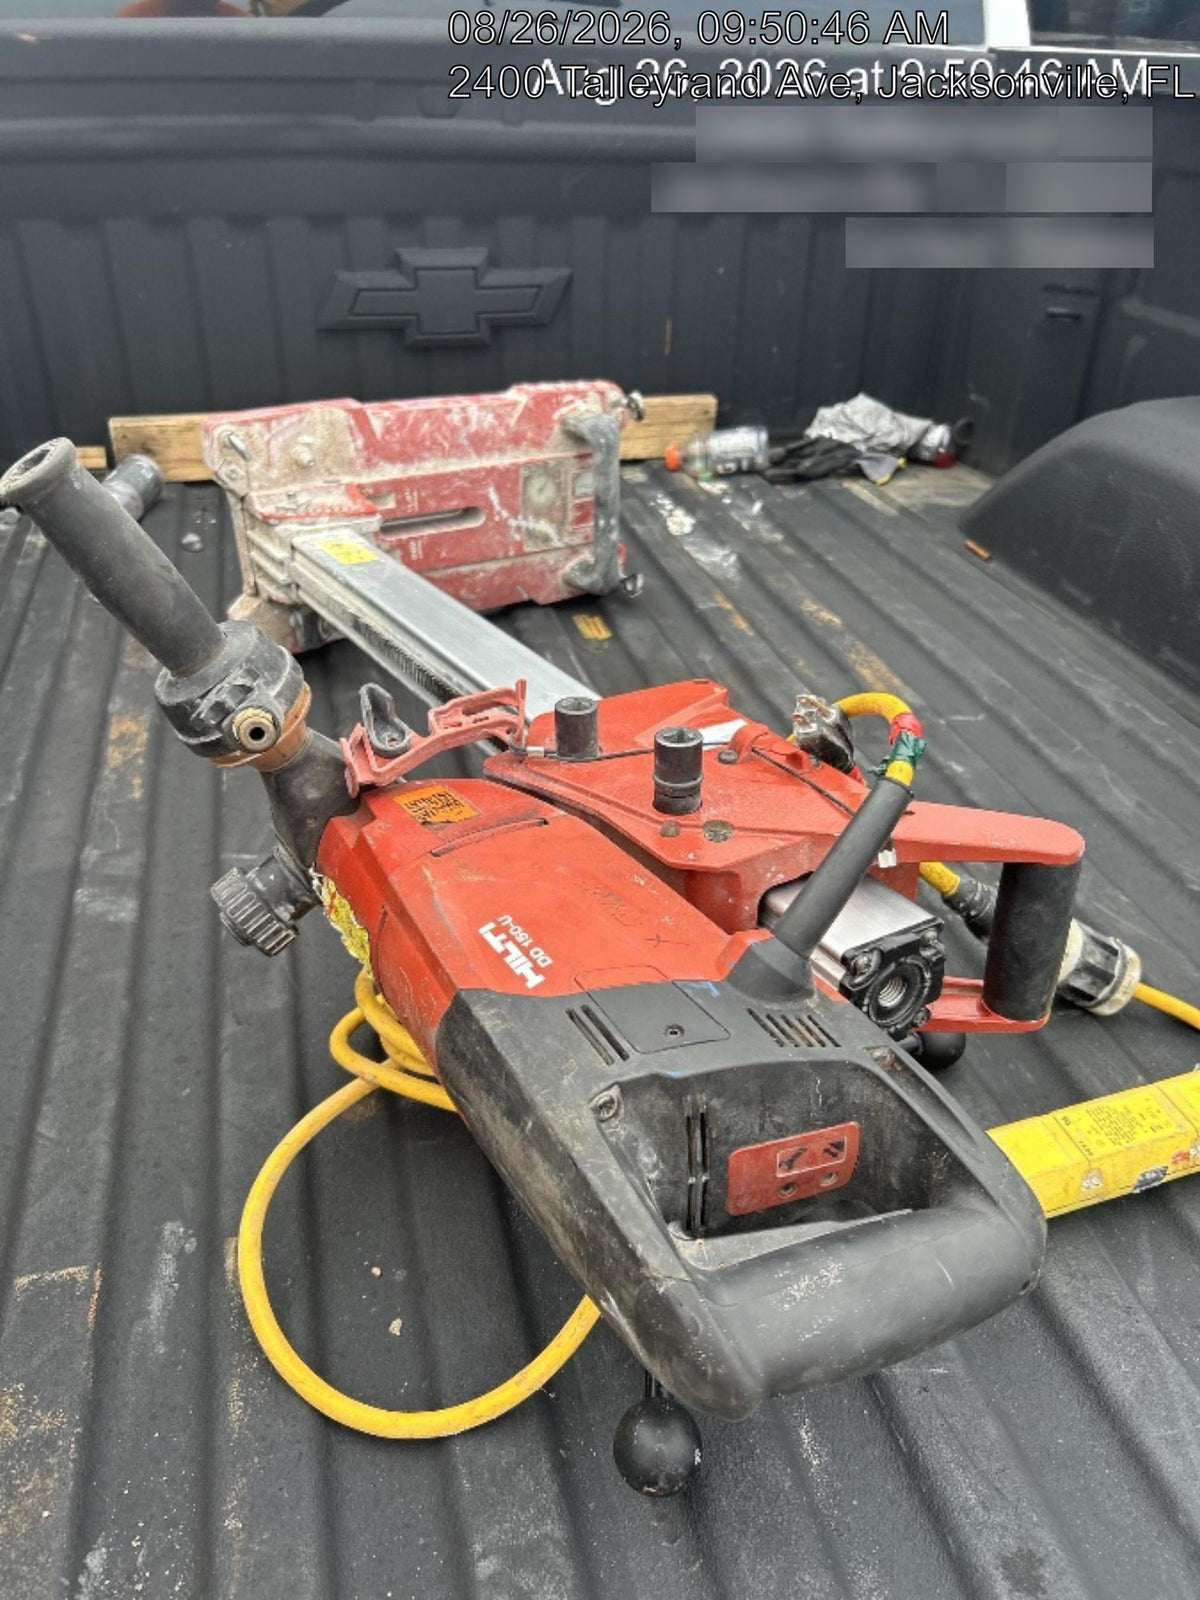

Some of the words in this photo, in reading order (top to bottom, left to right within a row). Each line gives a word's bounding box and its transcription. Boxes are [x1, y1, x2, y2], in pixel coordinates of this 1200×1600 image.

[498, 914, 533, 947] 150-U
[478, 922, 545, 989] HILTI
[528, 946, 554, 968] DD
